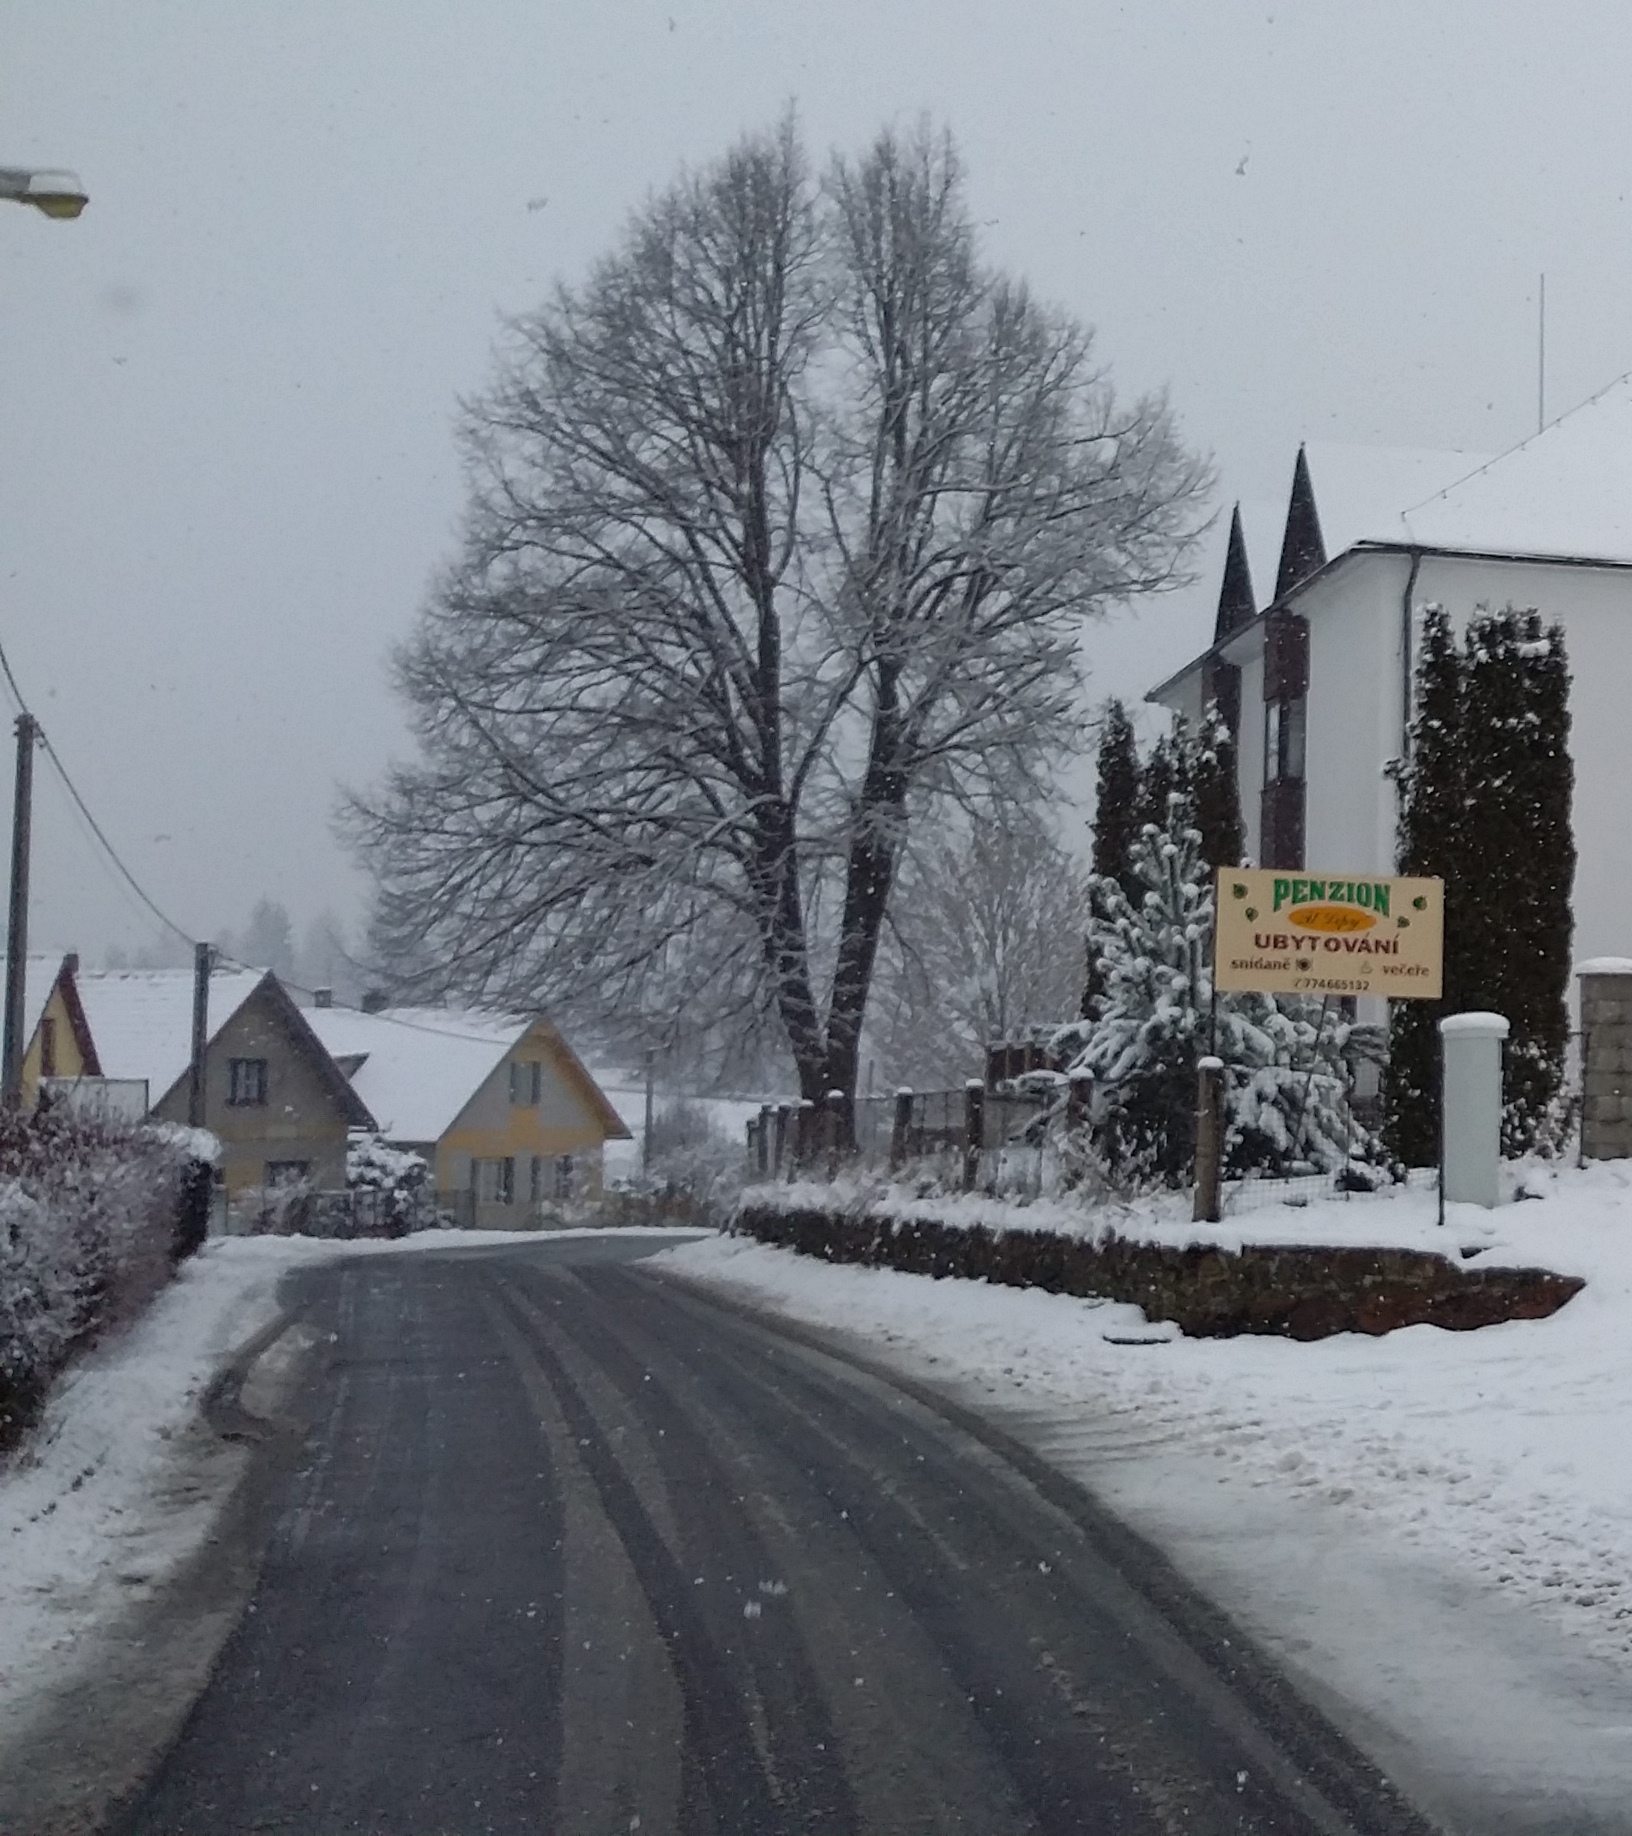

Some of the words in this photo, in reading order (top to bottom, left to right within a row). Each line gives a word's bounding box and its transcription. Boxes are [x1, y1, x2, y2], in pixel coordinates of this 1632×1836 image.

[1273, 878, 1391, 919] PENZION
[1254, 932, 1401, 955] UBYTOVÁNÍ
[1230, 956, 1291, 970] snídaně
[1382, 963, 1430, 976] večeře
